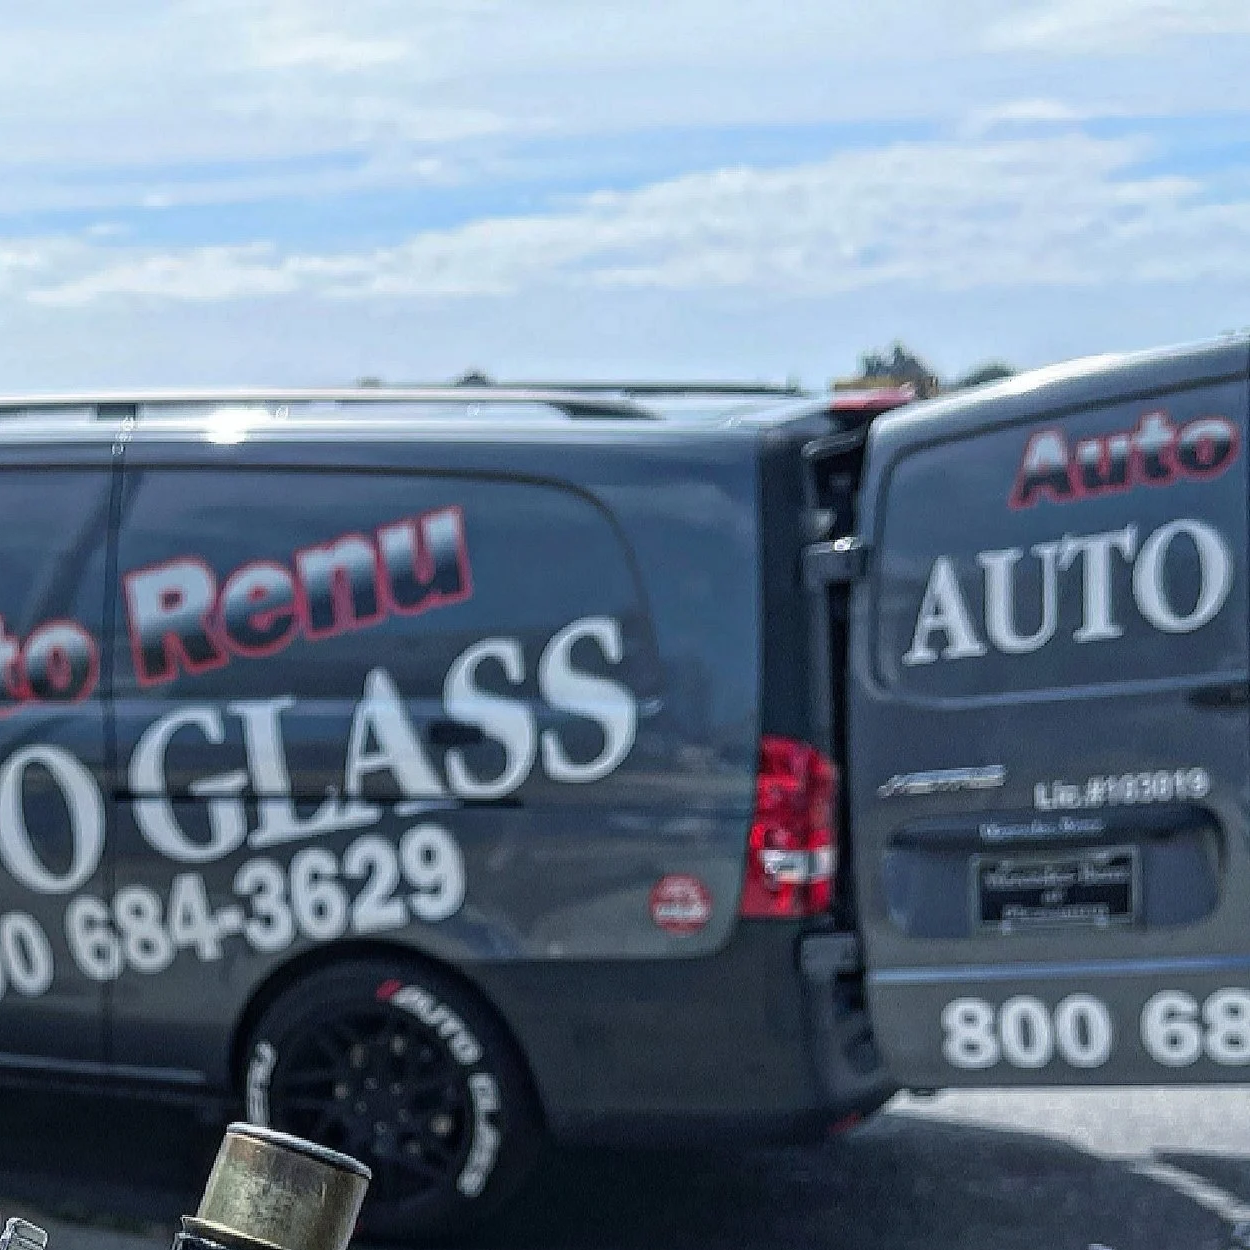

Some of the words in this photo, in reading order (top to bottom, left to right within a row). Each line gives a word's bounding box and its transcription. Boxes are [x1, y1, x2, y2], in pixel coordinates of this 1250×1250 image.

[1010, 410, 1238, 509] Auto
[123, 506, 473, 687] Renu
[902, 518, 1233, 665] AUTO
[128, 616, 637, 864] GLASS
[65, 823, 465, 981] 684-3629
[942, 993, 1112, 1068] 800
